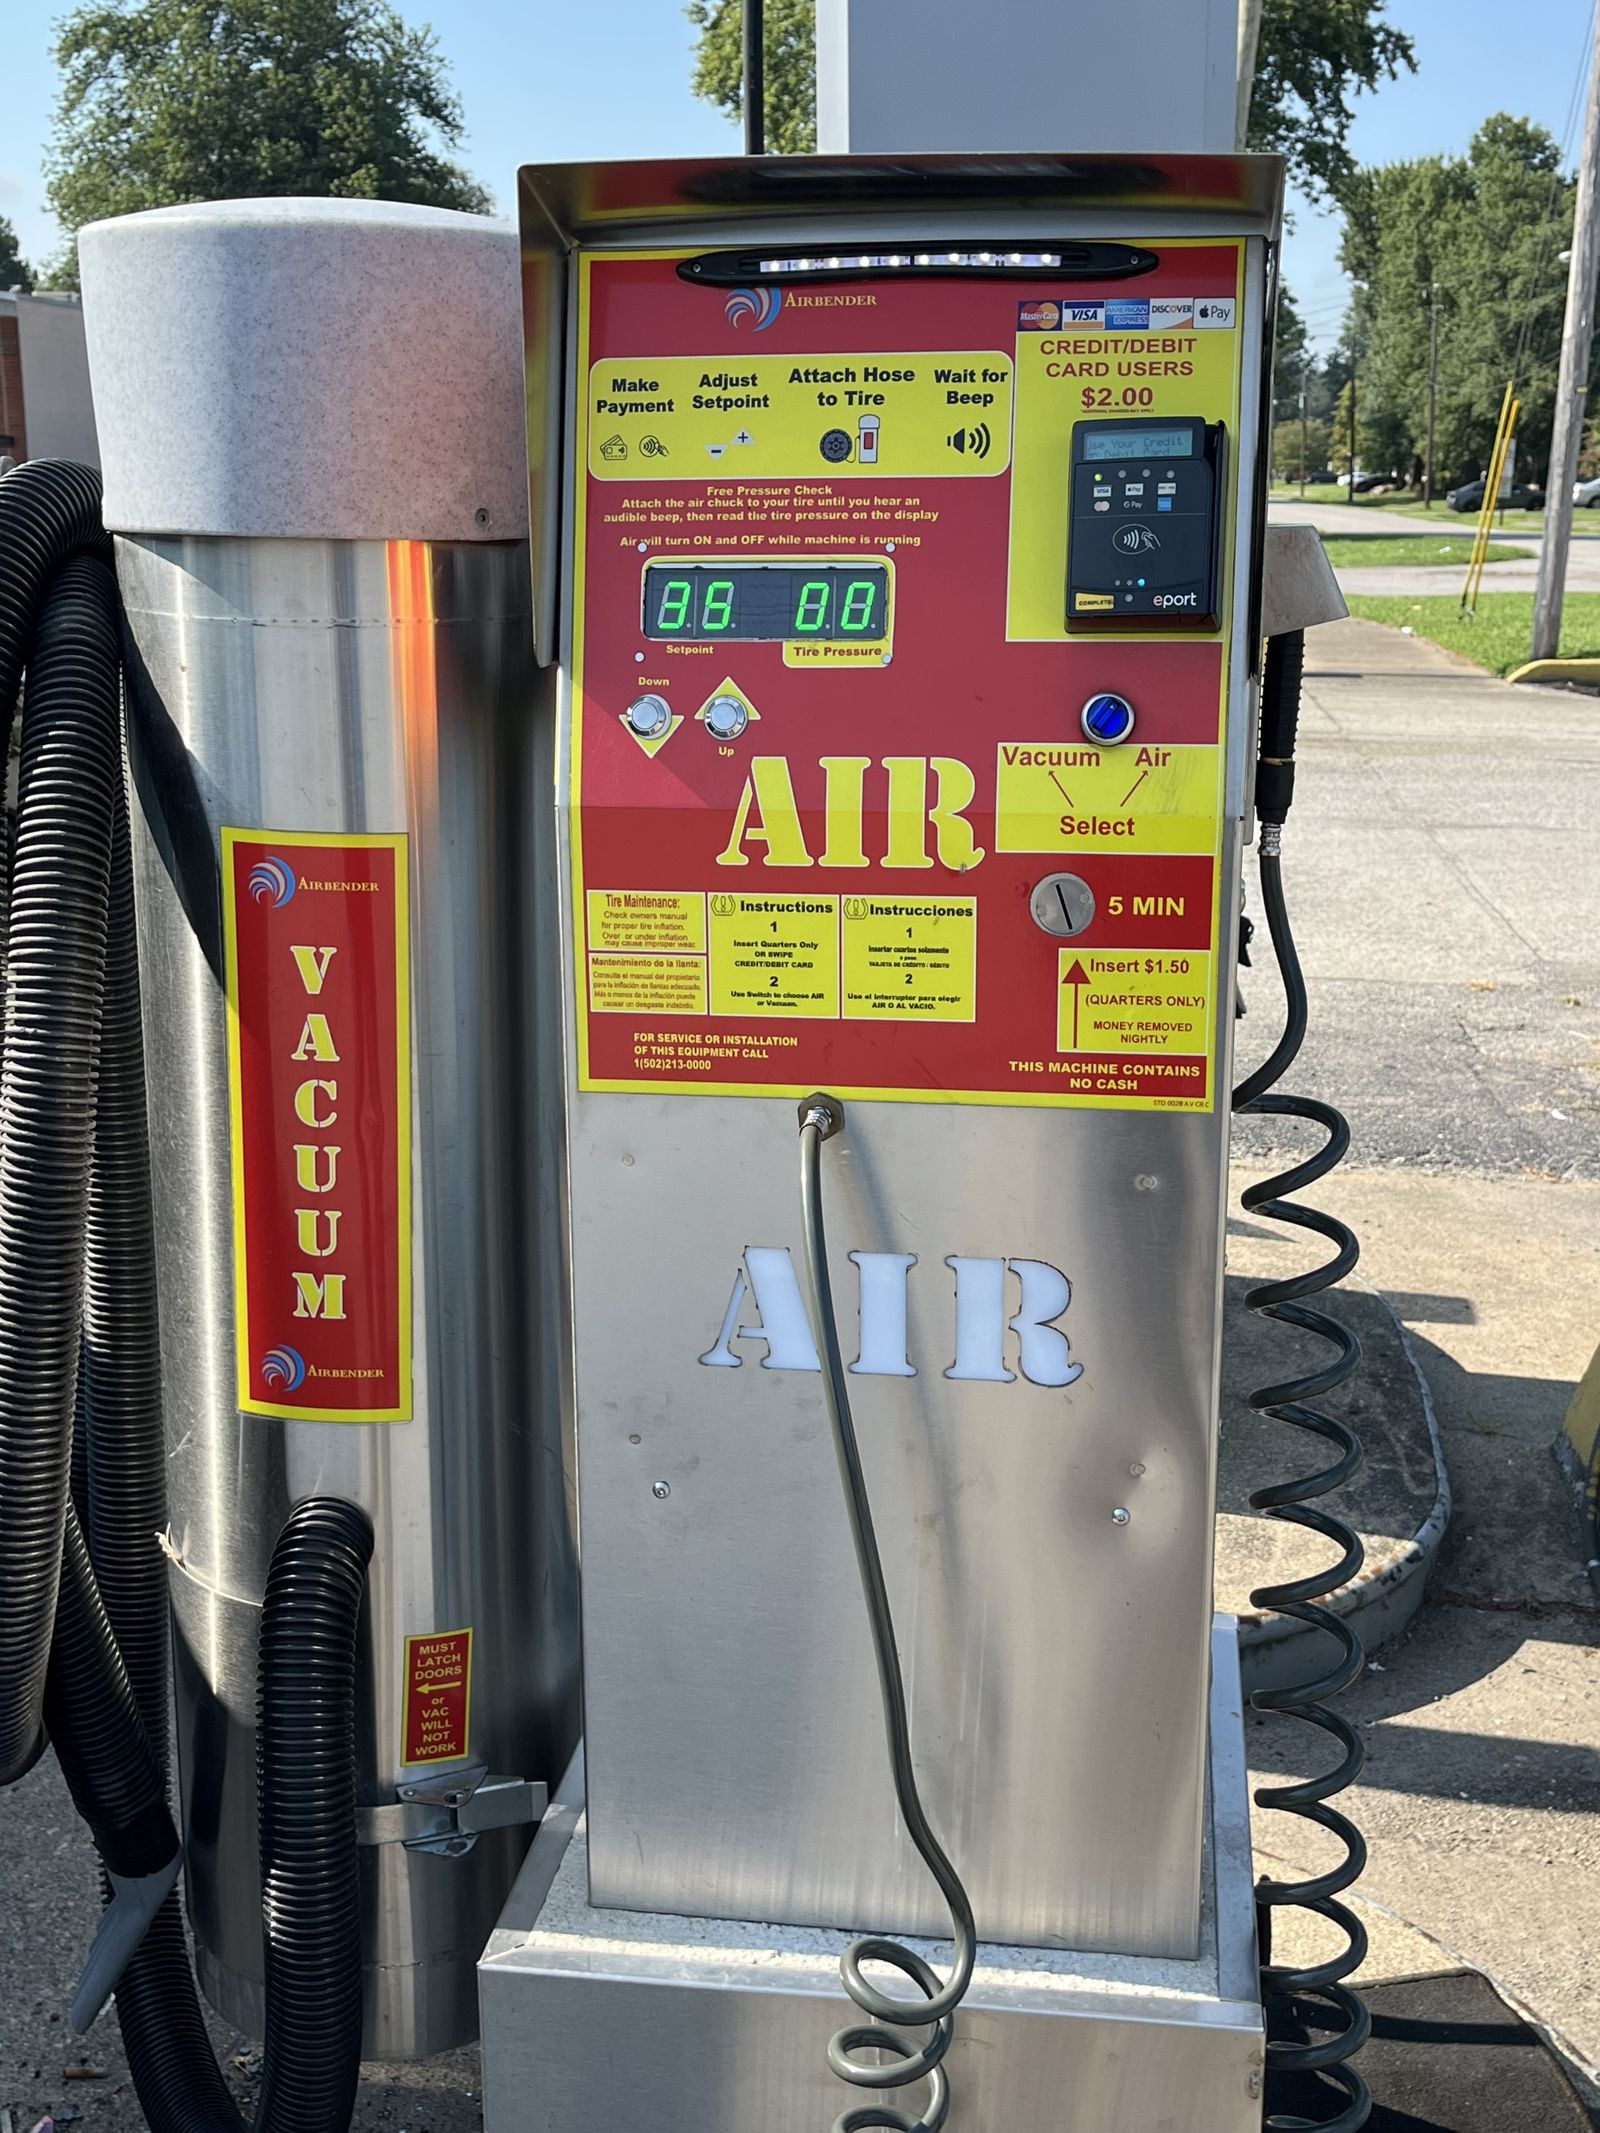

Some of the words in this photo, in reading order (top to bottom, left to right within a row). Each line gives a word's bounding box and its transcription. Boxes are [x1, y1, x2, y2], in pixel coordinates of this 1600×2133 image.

[785, 293, 877, 307] AIRBENDER
[1072, 311, 1098, 320] VISA
[1106, 306, 1147, 314] AMERICAN
[1152, 305, 1192, 313] DISCOVER
[1211, 306, 1230, 321] Pay
[1021, 312, 1059, 321] MasterCard
[1040, 339, 1197, 354] CREDIT/DEBIT
[789, 369, 856, 383] Attach
[864, 368, 915, 382] Hose
[1046, 363, 1109, 377] CARD
[1118, 362, 1193, 376] USERS
[699, 374, 757, 388] Adjust
[935, 370, 975, 383] Wait
[981, 370, 1008, 383] for
[612, 379, 659, 392] Make
[692, 395, 769, 411] Setpoint
[818, 392, 837, 406] to
[845, 391, 884, 405] Tire
[947, 391, 993, 407] Beep
[1082, 387, 1153, 407] $2.00
[597, 399, 674, 415] Payment
[1144, 438, 1183, 446] Credit
[707, 486, 734, 496] Free
[737, 486, 791, 495] Pressure
[794, 485, 832, 495] Check
[622, 498, 661, 509] Attach
[665, 498, 684, 508] the
[688, 498, 704, 508] air
[707, 497, 744, 507] chuck
[748, 498, 760, 507] to
[763, 499, 789, 509] your
[793, 497, 814, 507] tire
[818, 496, 845, 506] until
[848, 498, 870, 508] you
[874, 496, 901, 506] hear
[604, 512, 647, 522] audible
[650, 512, 683, 523] beep,
[687, 512, 713, 522] then
[717, 512, 744, 521] read
[748, 512, 767, 521] the
[771, 511, 792, 521] tire
[795, 512, 848, 522] pressure
[852, 512, 867, 520] on
[871, 511, 891, 520] the
[895, 510, 938, 521] display
[620, 537, 637, 546] Air
[641, 536, 661, 545] will
[665, 536, 690, 545] turn
[694, 536, 711, 545] ON
[715, 536, 737, 545] and
[741, 536, 764, 544] OFF
[768, 535, 800, 544] while
[805, 535, 856, 544] machine
[860, 535, 870, 544] is
[874, 535, 920, 546] running
[657, 582, 735, 629] 35
[1154, 592, 1196, 608] eport
[666, 645, 713, 655] Setpoint
[794, 647, 819, 657] Tire
[824, 646, 882, 656] Pressure
[638, 677, 669, 685] Down
[719, 747, 734, 756] Up
[1002, 747, 1100, 767] Vacuum
[1135, 747, 1170, 767] Air
[716, 756, 985, 870] AIR
[1059, 816, 1135, 836] Select
[298, 876, 379, 893] AIRBENDER
[606, 894, 621, 907] Tire
[624, 895, 680, 908] Maintenance:
[741, 901, 833, 913] Instructions
[1108, 897, 1123, 916] 5
[1133, 897, 1185, 916] MIN
[870, 904, 973, 916] Instrucciones
[770, 921, 777, 932] 1
[906, 928, 912, 938] 1
[800, 942, 818, 950] Only
[592, 958, 652, 967] Mantenimiento
[654, 959, 664, 967] de
[666, 959, 673, 967] la
[1090, 959, 1139, 973] Insert
[1145, 959, 1189, 974] $1.50
[770, 976, 778, 987] 2
[905, 974, 912, 984] 2
[1086, 994, 1163, 1007] (QUARTERS
[1167, 996, 1205, 1009] ONLY)
[1093, 1021, 1134, 1031] MONEY
[1137, 1022, 1192, 1032] REMOVED
[634, 1033, 654, 1043] FOR
[657, 1034, 702, 1044] SERVICE
[705, 1035, 719, 1045] OR
[723, 1035, 798, 1046] INSTALLATION
[1121, 1034, 1168, 1044] NIGHTLY
[634, 1046, 648, 1055] OF
[650, 1046, 675, 1056] THIS
[678, 1047, 739, 1058] EQUIPMENT
[742, 1048, 768, 1058] CALL
[634, 1059, 711, 1071] 1(502)213-0000
[1009, 1061, 1044, 1073] THIS
[1048, 1062, 1118, 1074] MACHINE
[1123, 1064, 1200, 1077] CONTAINS
[1070, 1078, 1091, 1089] NO
[1095, 1079, 1137, 1090] CASH
[290, 945, 346, 1319] VACUUM
[699, 1245, 1084, 1388] AIR
[308, 1364, 384, 1380] AIRBENDER
[419, 1642, 456, 1654] MUST
[417, 1654, 460, 1667] LATCH
[415, 1666, 462, 1680] DOORS
[432, 1697, 445, 1705] or
[422, 1707, 449, 1718] VAC
[421, 1720, 452, 1731] WILL
[423, 1731, 450, 1742] NOT
[416, 1742, 456, 1755] WORK
